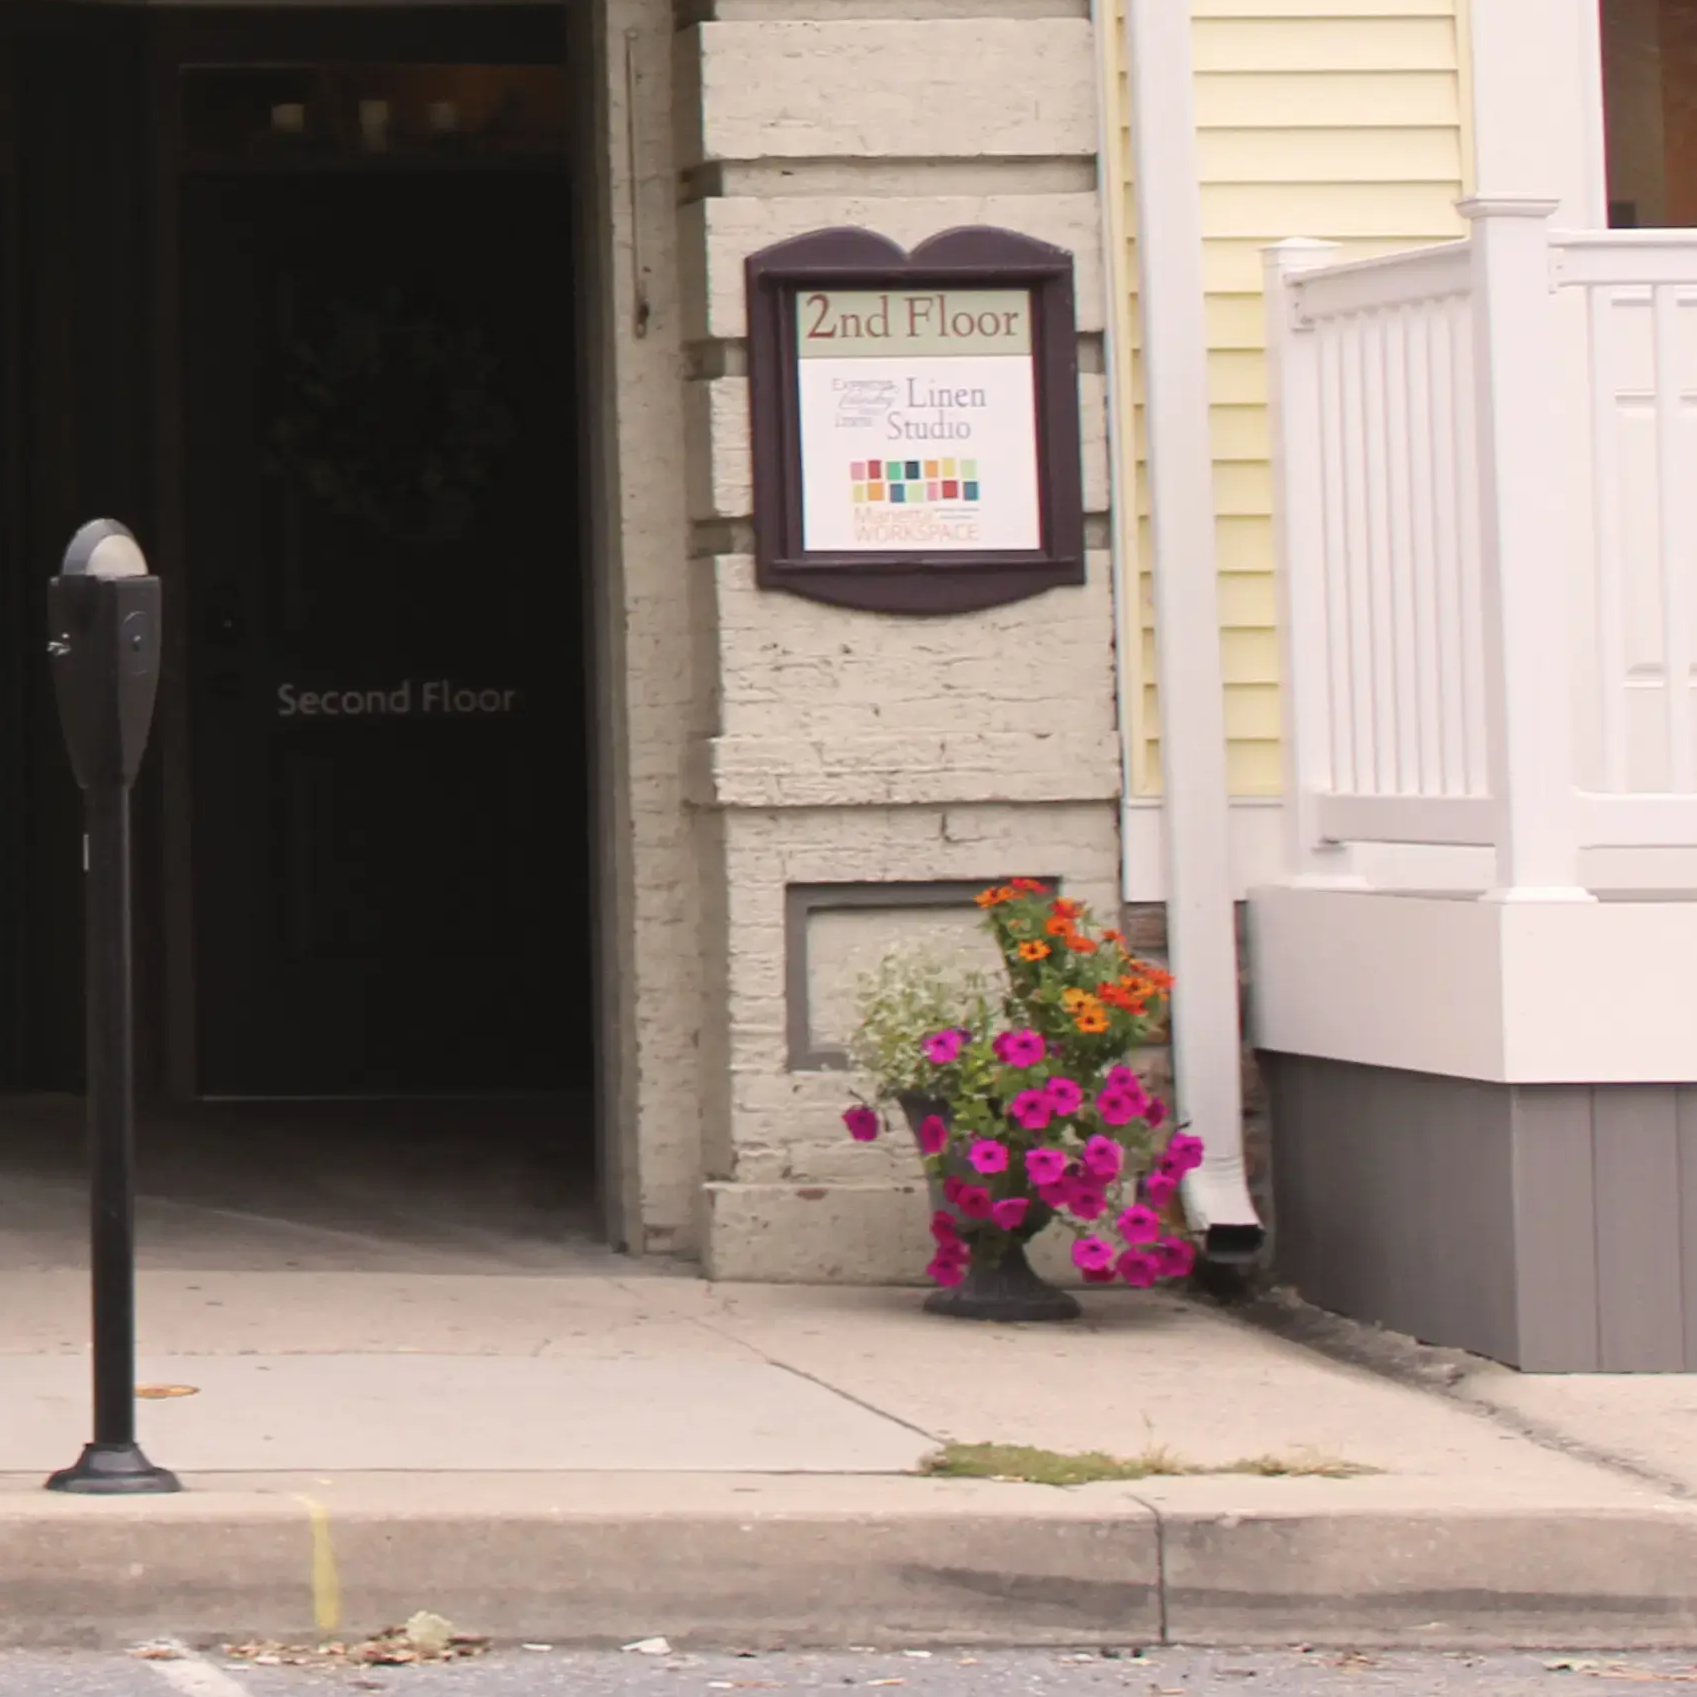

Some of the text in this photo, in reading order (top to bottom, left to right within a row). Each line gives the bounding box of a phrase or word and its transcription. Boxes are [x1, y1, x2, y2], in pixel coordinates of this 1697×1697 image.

[806, 293, 1019, 339] 2nd Floor
[906, 377, 987, 408] Linen
[886, 410, 972, 440] Studio
[855, 524, 980, 542] WORKSPACE
[277, 679, 516, 716] Second Floor
